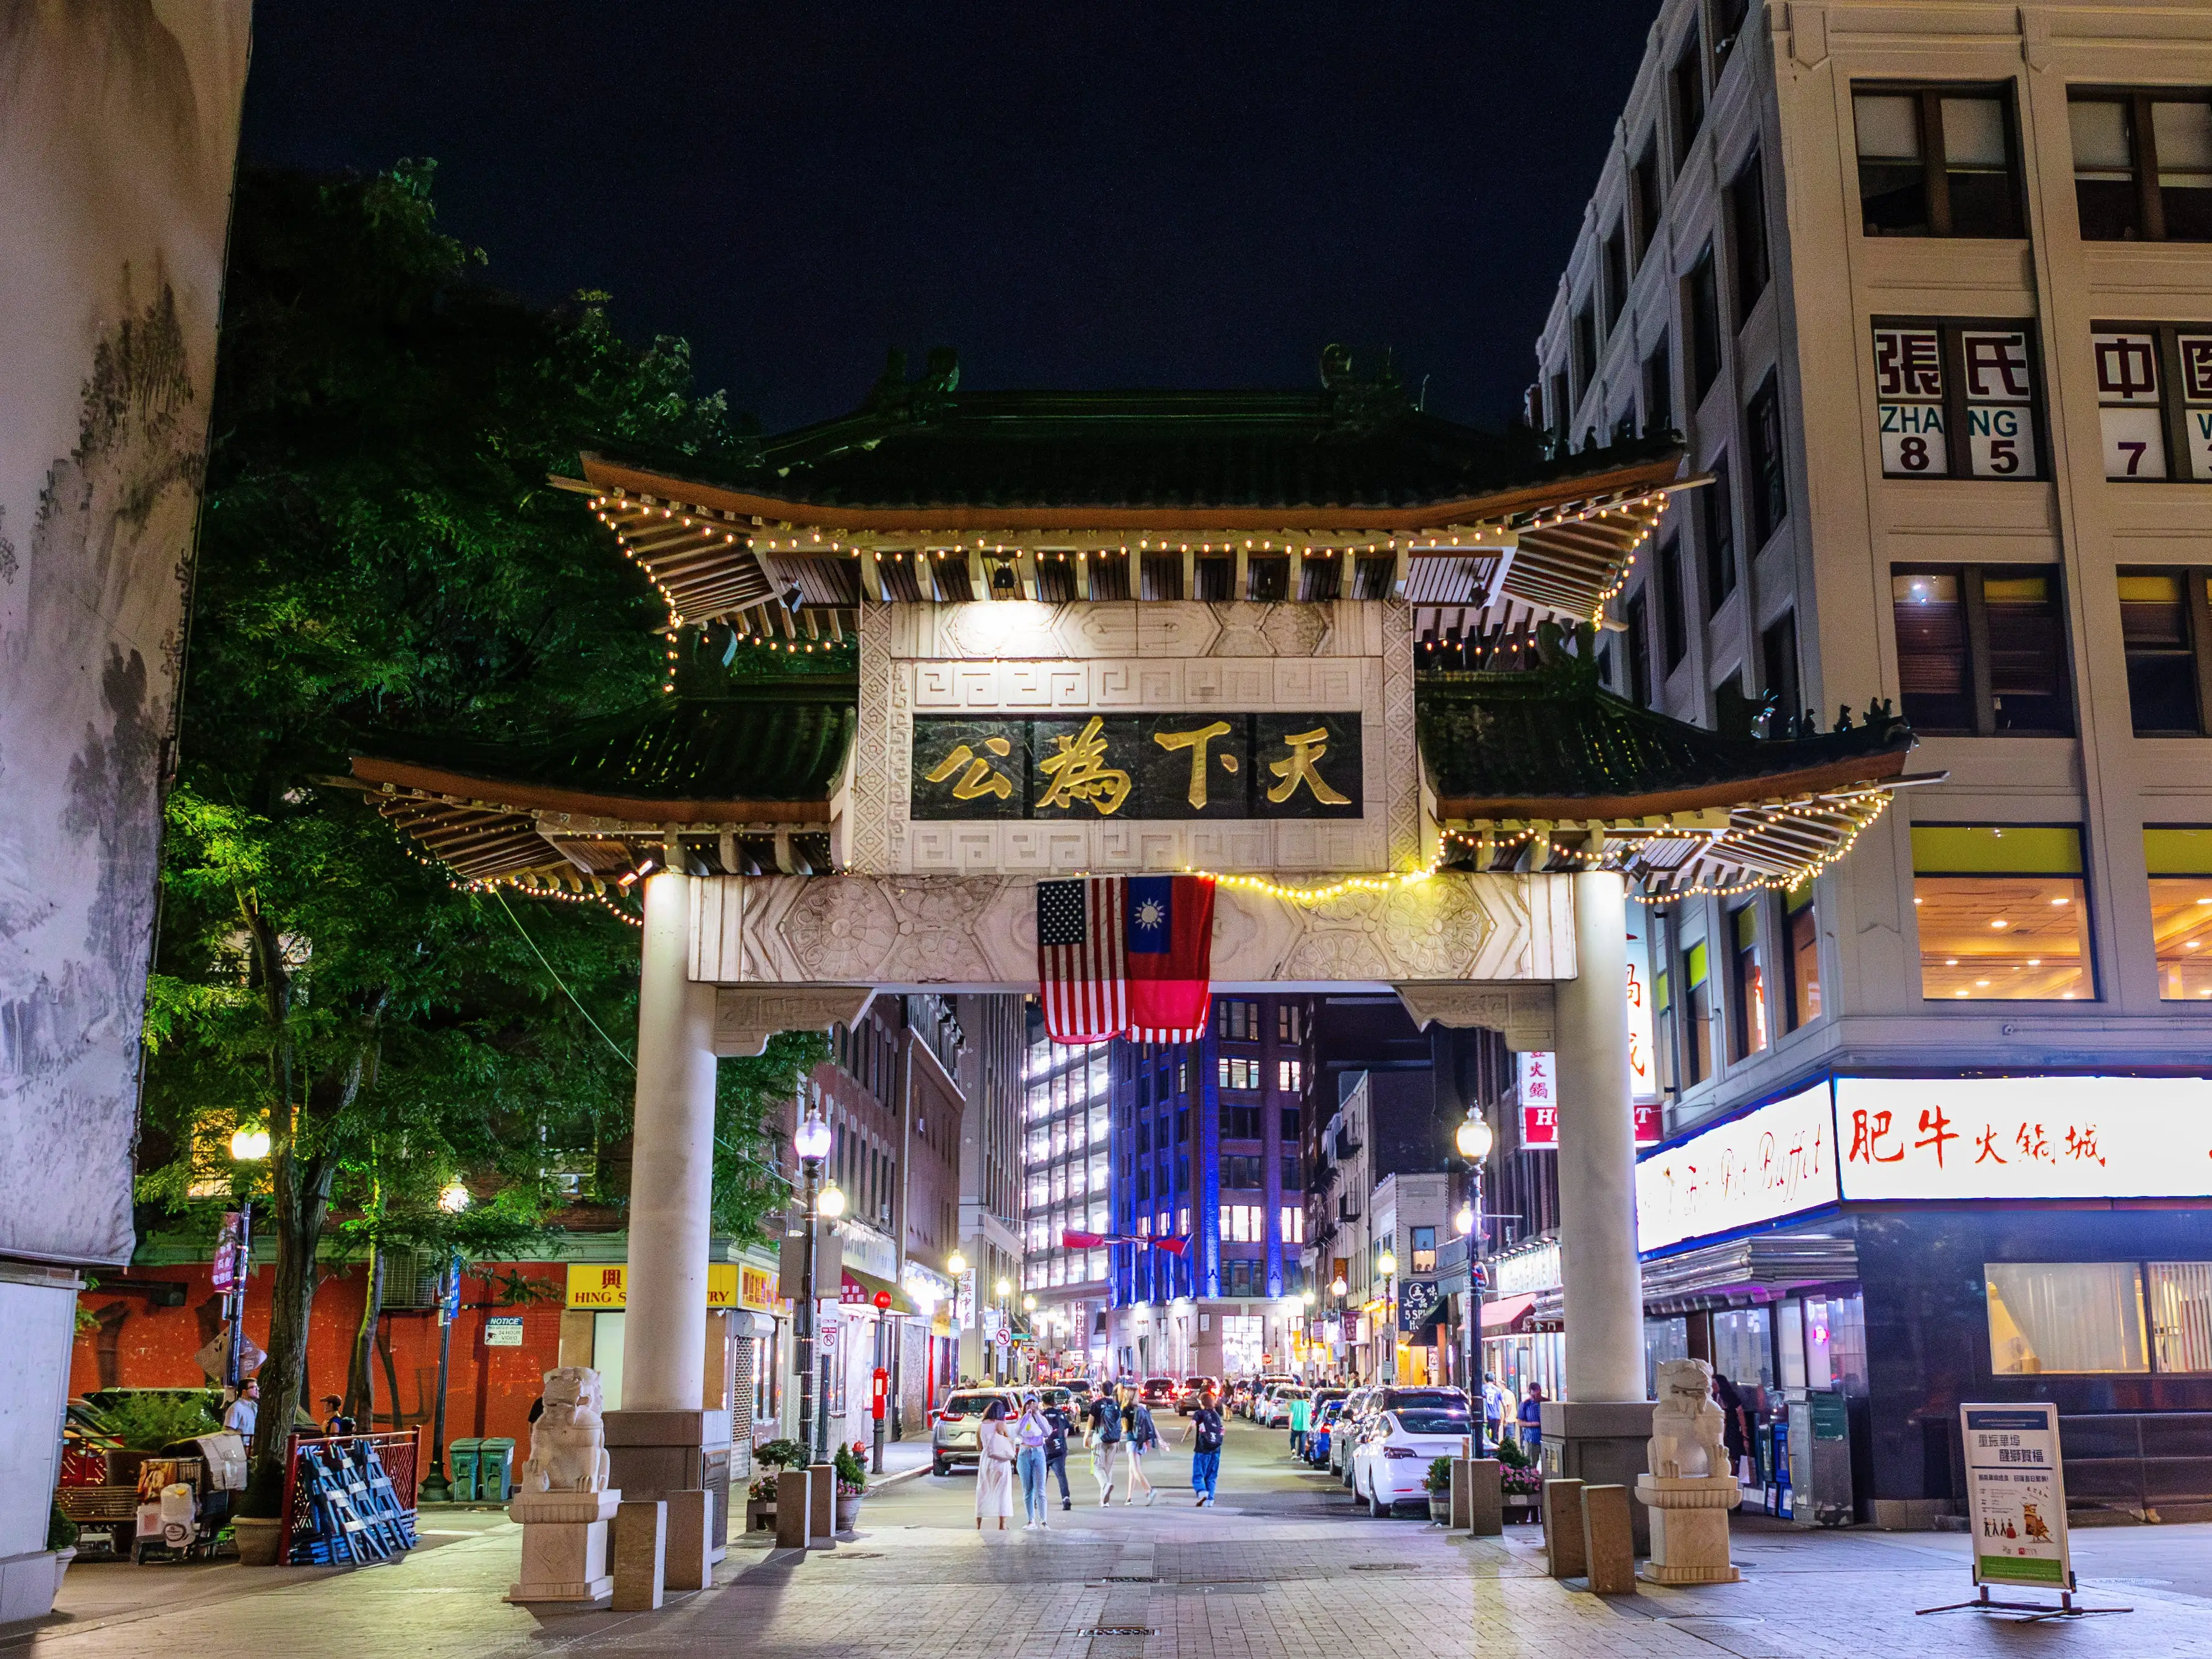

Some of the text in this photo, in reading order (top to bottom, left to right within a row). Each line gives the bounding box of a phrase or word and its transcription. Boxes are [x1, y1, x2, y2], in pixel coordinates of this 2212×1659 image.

[1876, 333, 2030, 397] 張氏
[1900, 437, 2147, 475] 8 5 7
[1848, 1105, 2107, 1171] 肥牛火鍋城
[575, 1292, 612, 1303] HING
